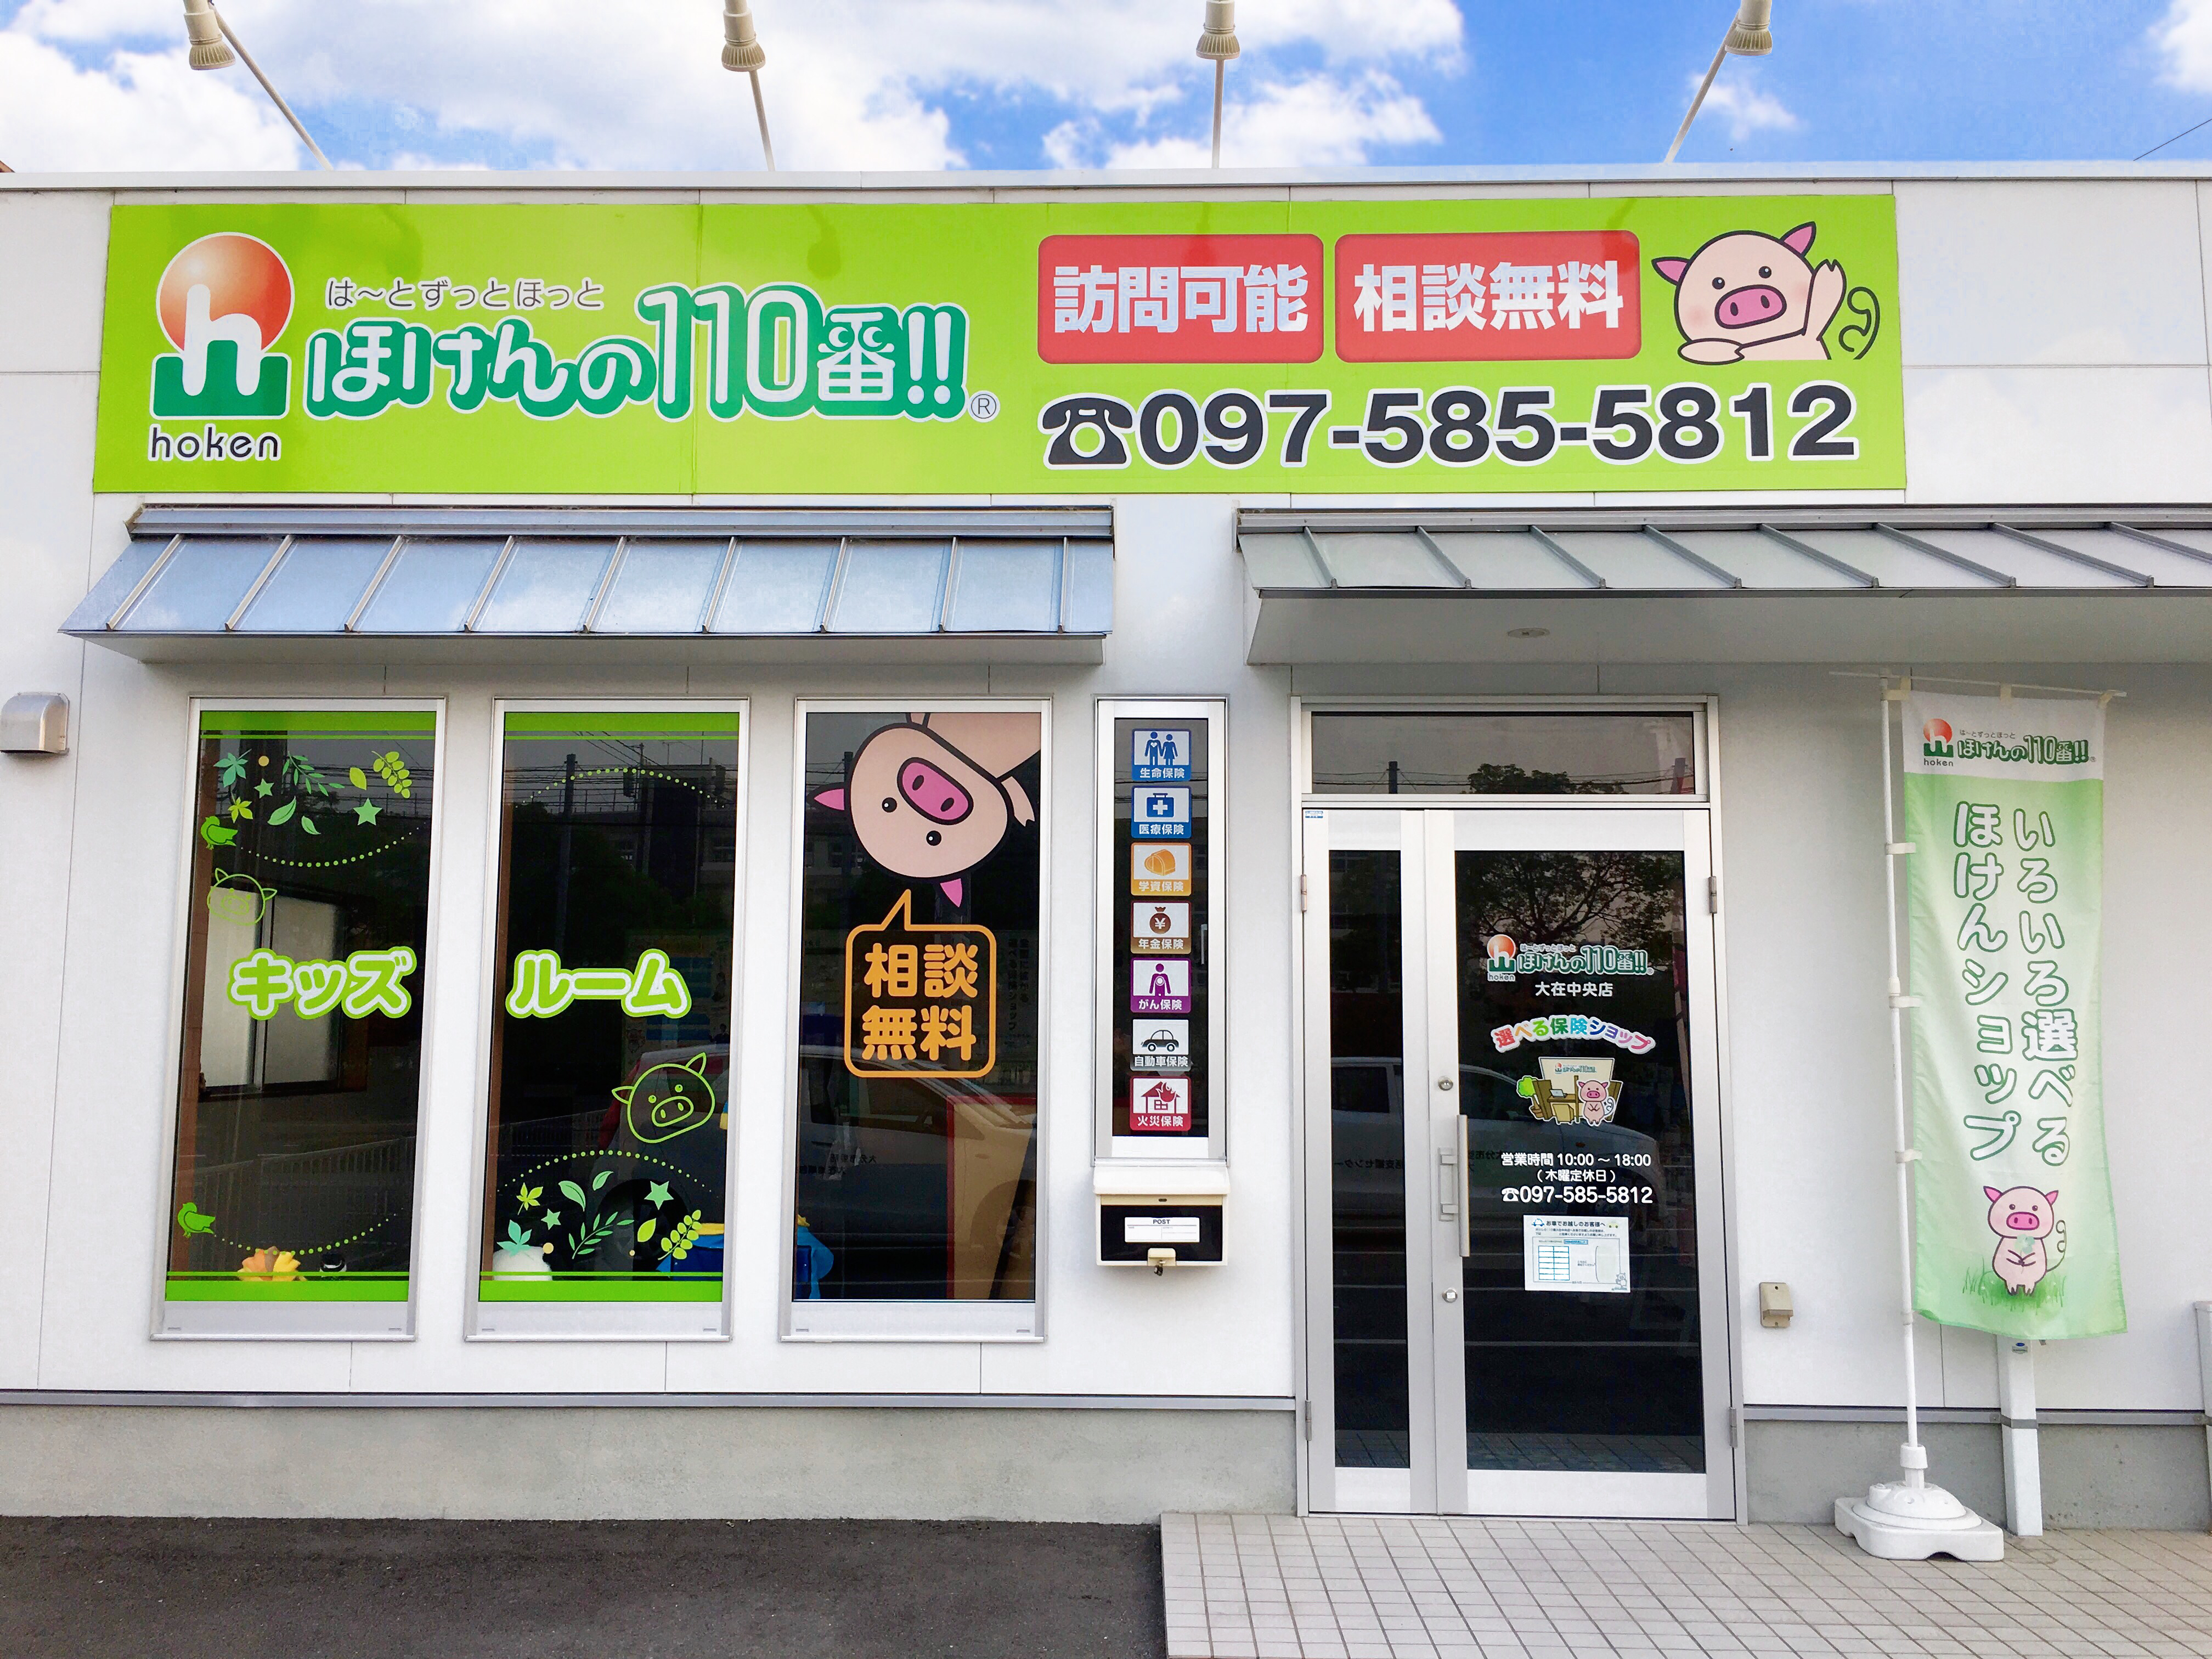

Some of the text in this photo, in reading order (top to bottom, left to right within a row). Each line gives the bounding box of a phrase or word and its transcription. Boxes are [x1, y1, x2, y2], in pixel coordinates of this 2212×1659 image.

[1053, 264, 1309, 334] 訪問可能
[1353, 260, 1624, 332] 相談無料
[305, 281, 969, 419] ほけんの110番!!
[1139, 385, 1855, 466] 097-585-5812
[150, 426, 279, 459] hoken
[1139, 768, 1185, 779] 生命保険
[1923, 758, 1954, 767] hoken
[1139, 823, 1184, 835] 医療保険
[1138, 881, 1184, 892] 学資保険
[1138, 938, 1184, 950] 年金保険
[864, 943, 978, 998] 相談
[1488, 973, 1515, 981] hoken
[1953, 800, 2022, 1161] ほけんショップ
[227, 947, 416, 1020] キッズ
[505, 949, 692, 1019] ルーム
[1535, 981, 1613, 997] 大在中央店
[2013, 808, 2079, 1167] いろいろ選べる
[1138, 999, 1182, 1011] がん保険
[862, 1005, 977, 1061] 無料
[1492, 1016, 1654, 1052] 選べる保険ショップ
[1134, 1056, 1188, 1067] 自動車保険
[1137, 1115, 1183, 1127] 火災保険
[1500, 1152, 1554, 1166] 営業時間
[1557, 1153, 1594, 1166] 10:00
[1614, 1153, 1651, 1166] 18:00
[1519, 1186, 1653, 1204] 097-585-5812
